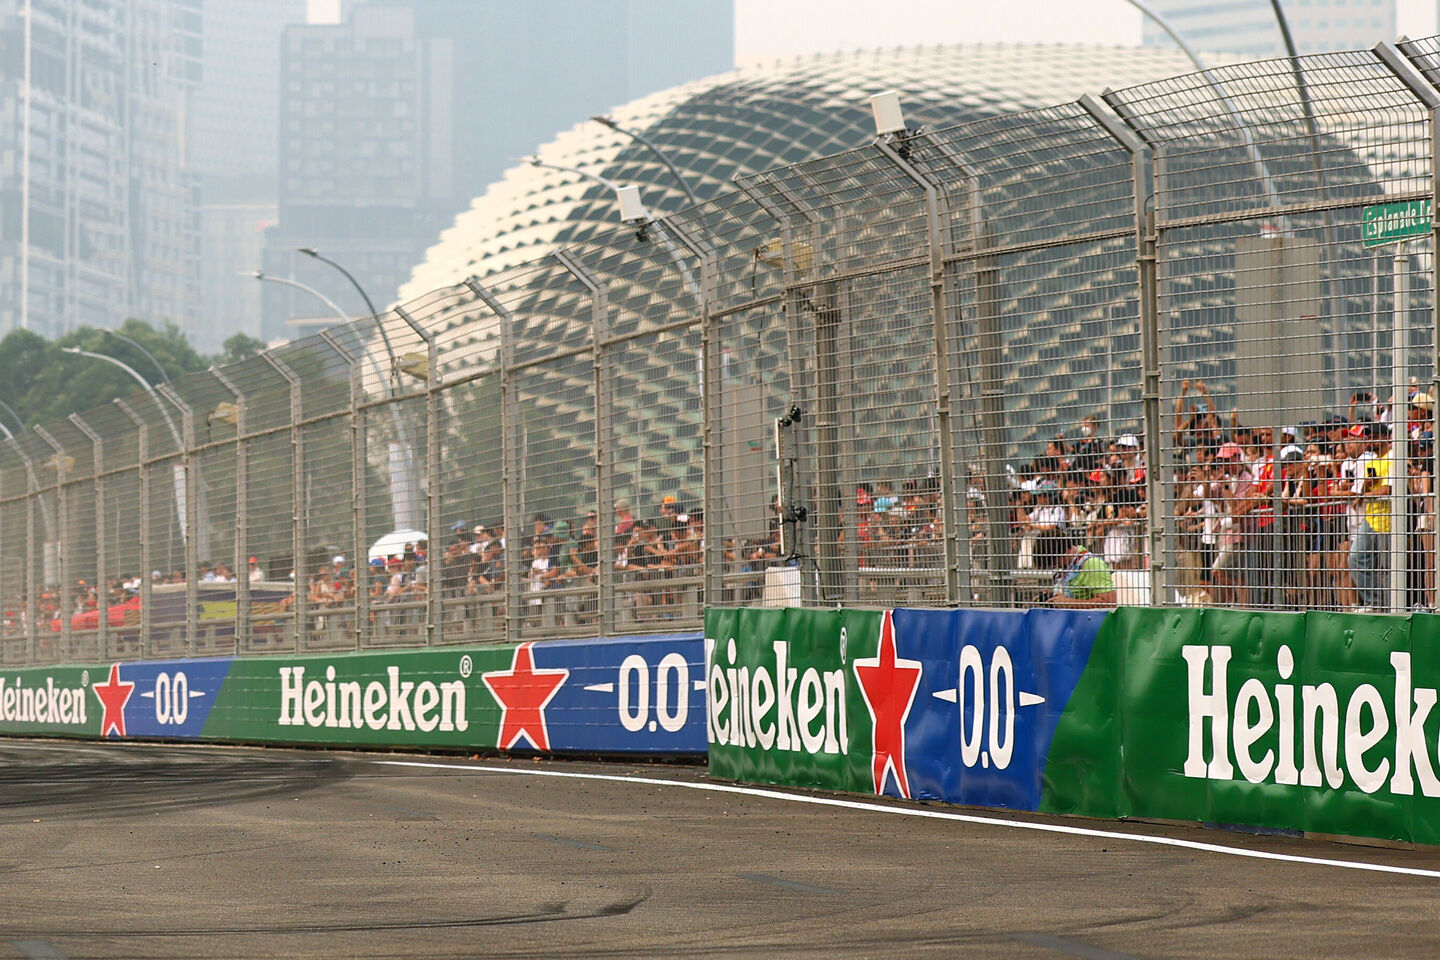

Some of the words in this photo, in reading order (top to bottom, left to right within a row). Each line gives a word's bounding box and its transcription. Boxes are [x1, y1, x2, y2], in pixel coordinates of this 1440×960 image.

[1367, 202, 1416, 238] Esplanade
[155, 671, 188, 726] 0.0
[278, 665, 469, 733] Heineken
[618, 652, 689, 733] 0.0
[960, 644, 1015, 770] 0.0
[1182, 644, 1440, 798] Heinek
